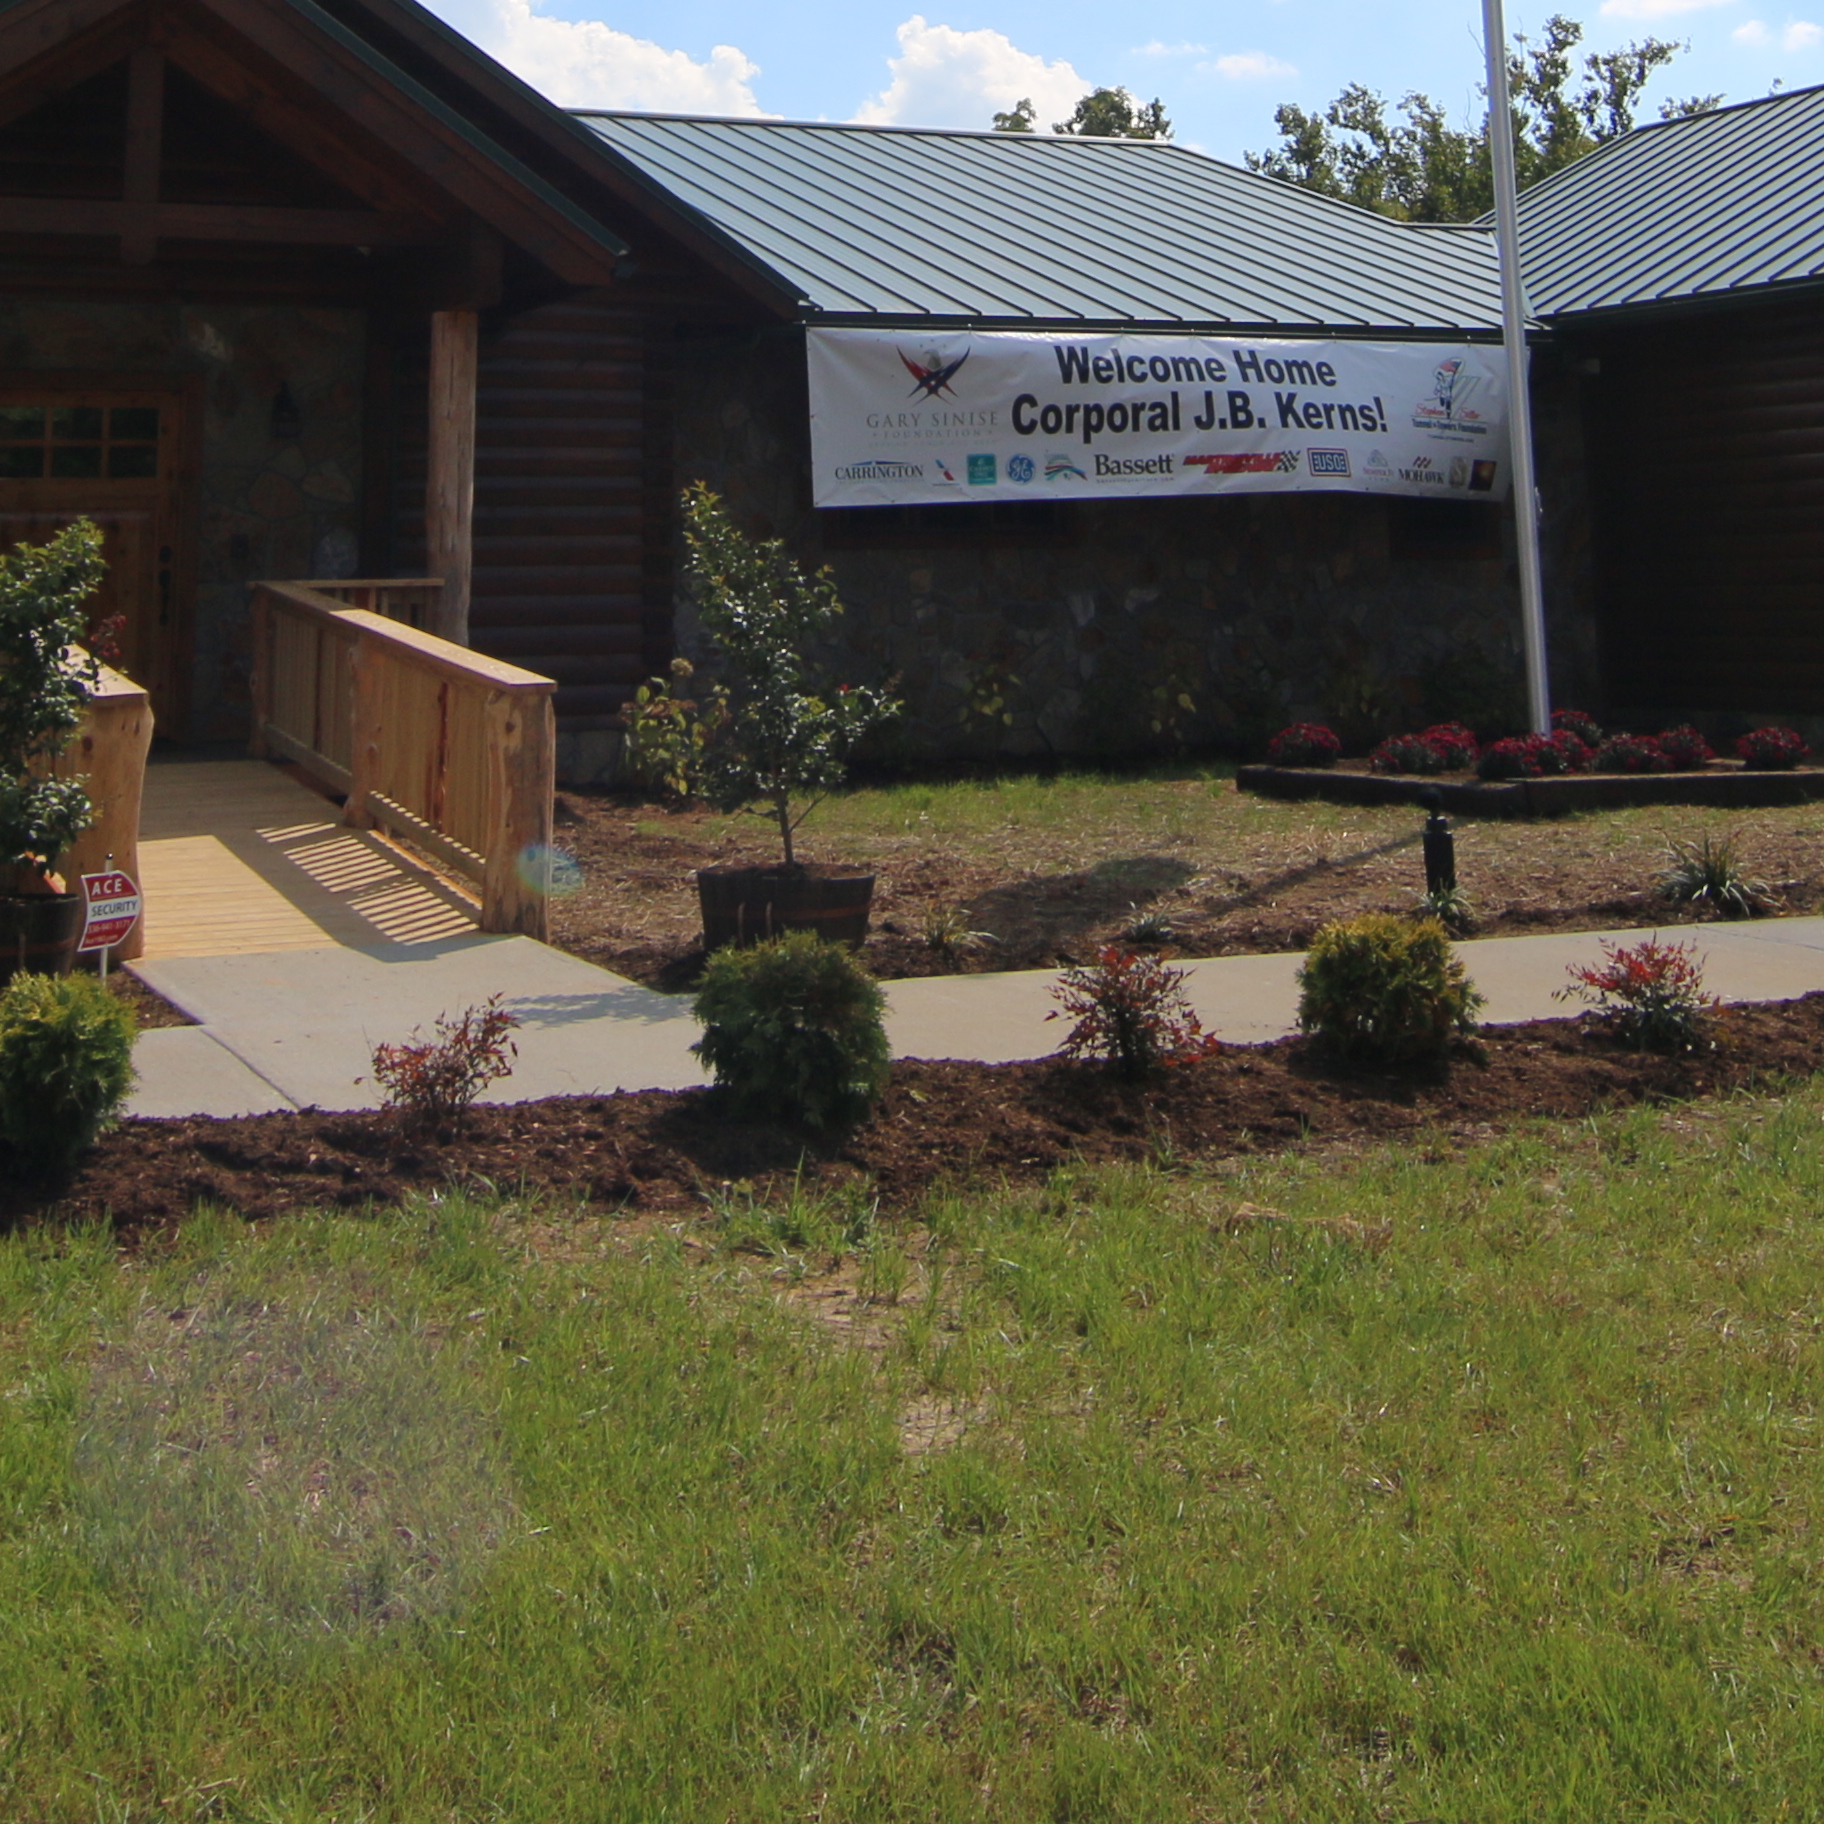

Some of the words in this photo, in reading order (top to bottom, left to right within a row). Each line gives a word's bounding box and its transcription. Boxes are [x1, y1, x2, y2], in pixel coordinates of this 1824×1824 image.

[1054, 345, 1226, 384] Welcome
[1233, 350, 1337, 387] Home
[866, 413, 922, 428] GARY
[931, 411, 998, 427] SINISE
[1012, 391, 1180, 444] Corporal
[1194, 390, 1267, 431] J.B.
[1274, 392, 1388, 432] Kerns!
[884, 429, 980, 438] FOUNDATION
[1094, 454, 1174, 476] Bassett
[1318, 453, 1342, 471] USO
[835, 465, 924, 480] CARRINGTON
[1398, 468, 1444, 483] MOHAWK
[92, 879, 122, 895] ACE
[92, 901, 137, 916] SECURITY
